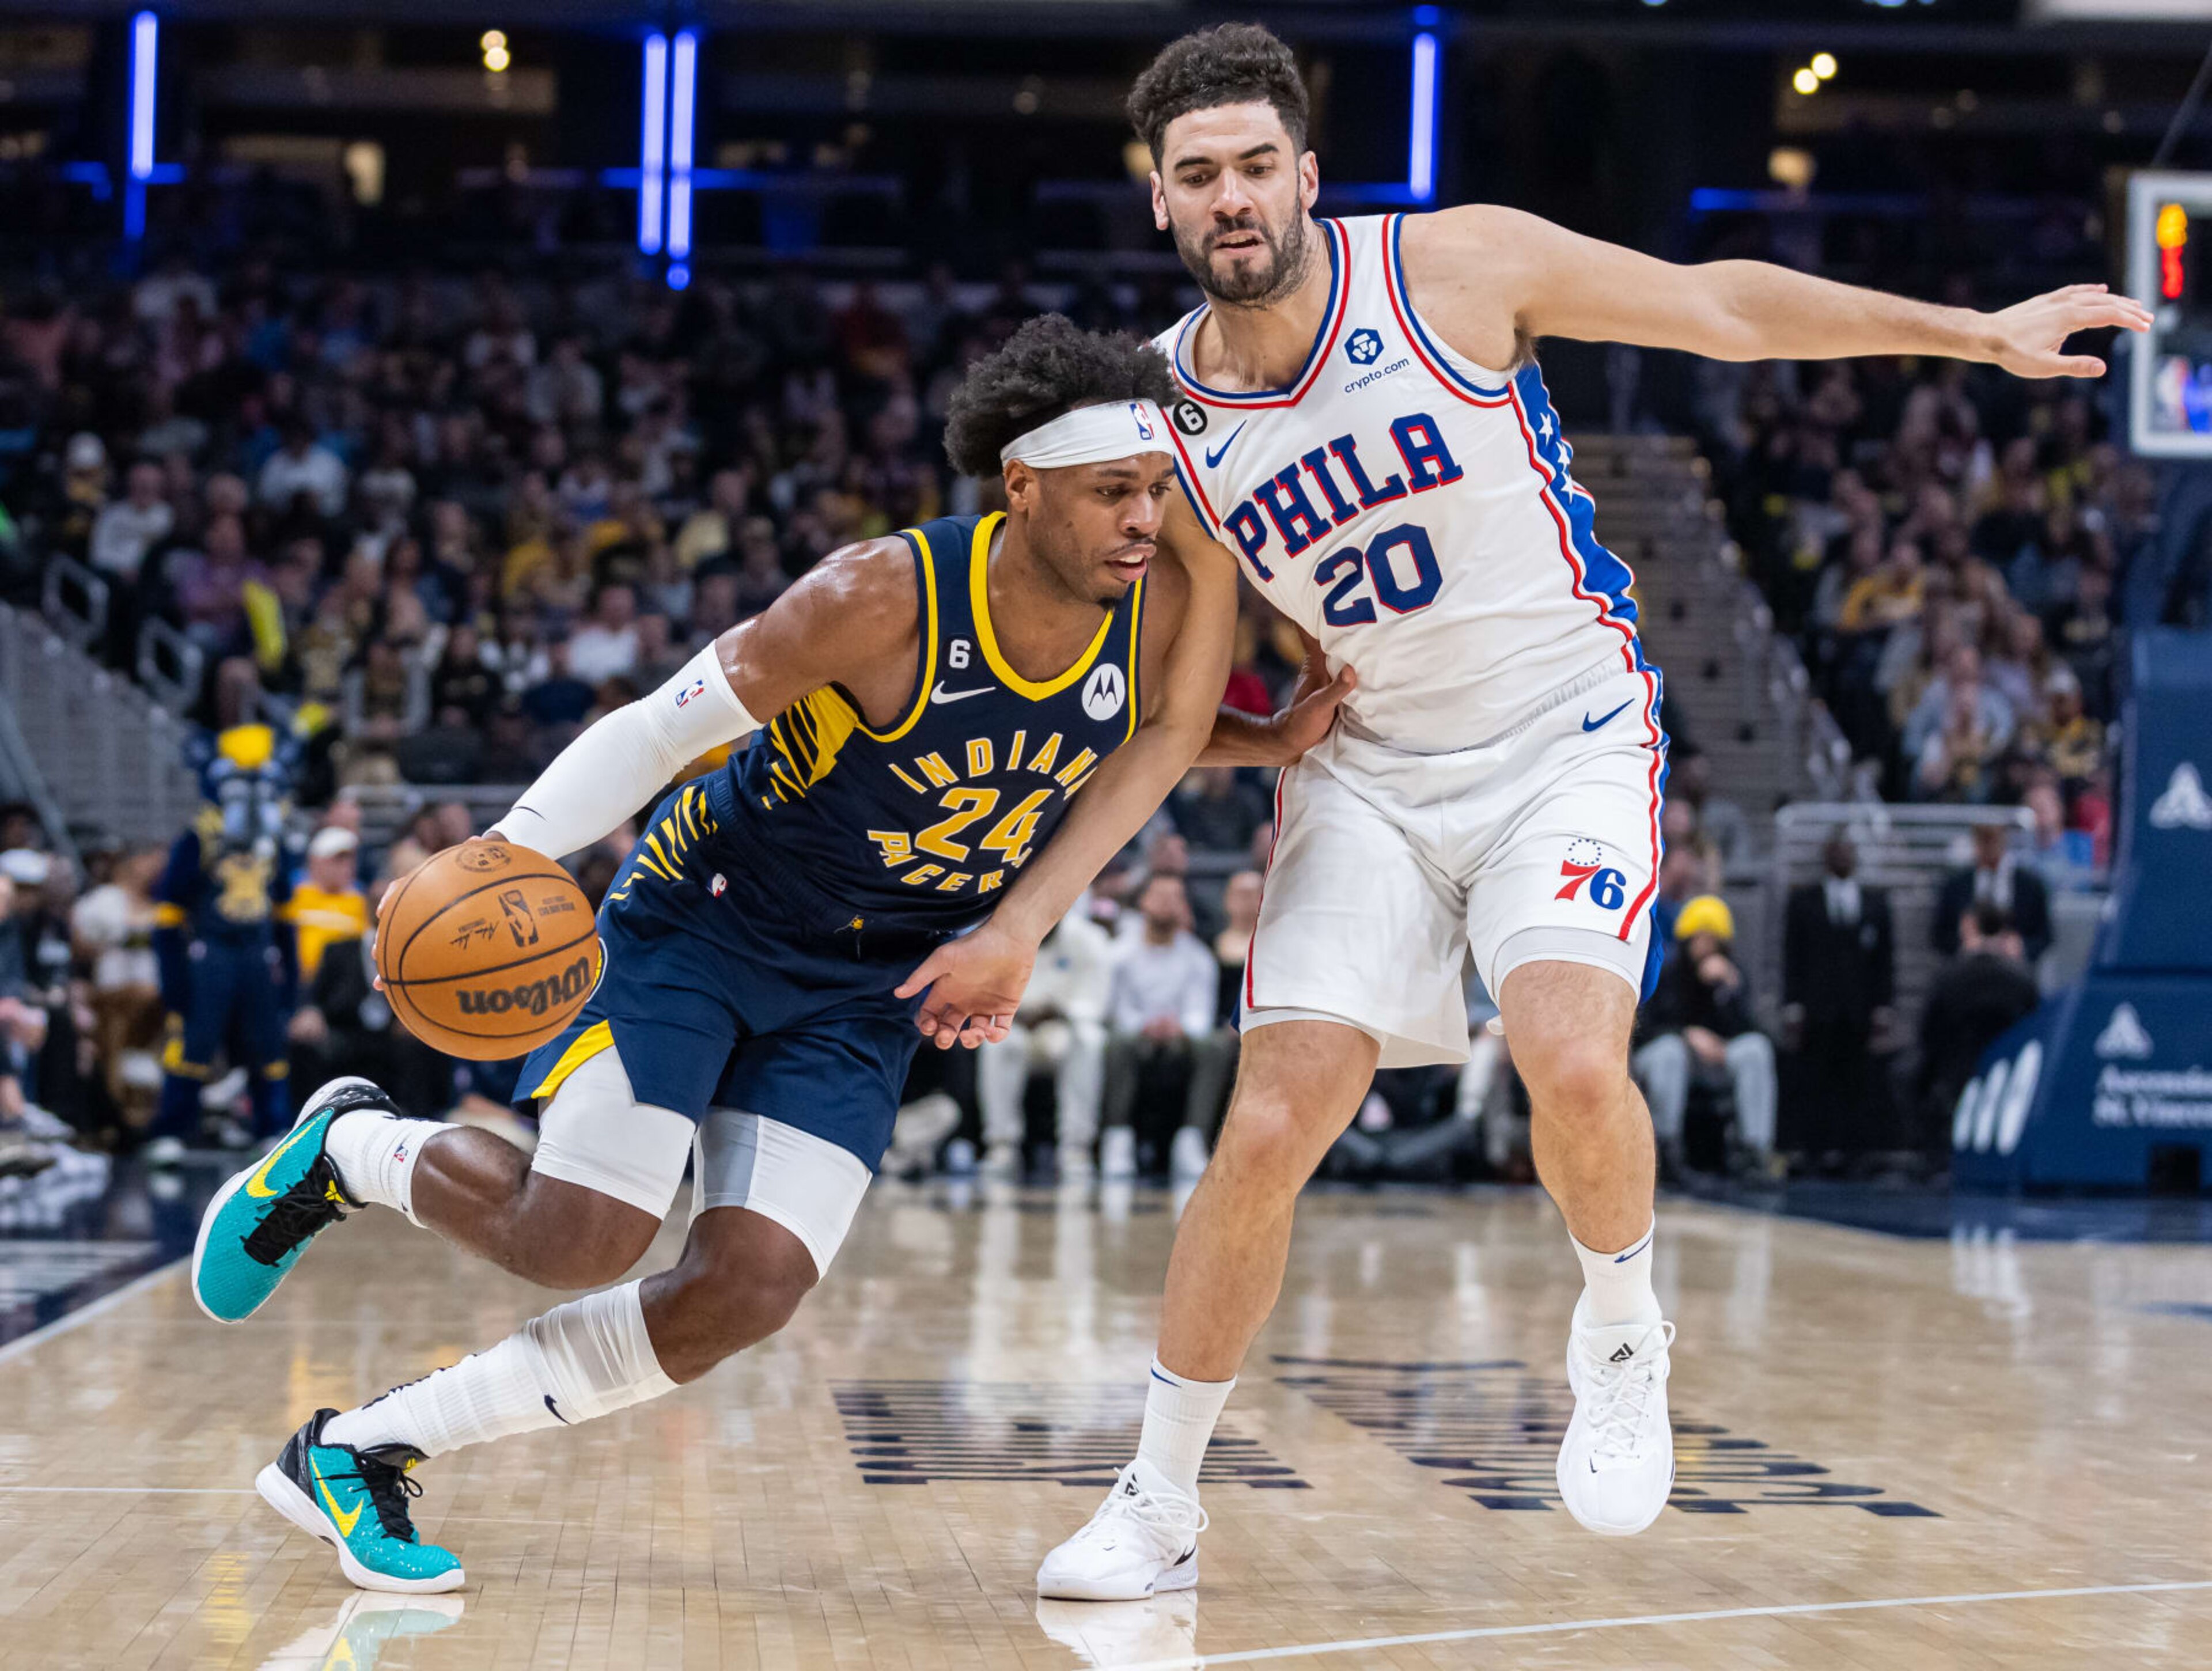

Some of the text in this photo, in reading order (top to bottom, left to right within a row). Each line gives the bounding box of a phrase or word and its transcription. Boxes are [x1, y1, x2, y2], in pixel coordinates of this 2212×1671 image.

[1344, 358, 1410, 393] crypto.com
[1179, 403, 1204, 431] 6
[1223, 412, 1464, 583] PHILA
[1314, 523, 1444, 626] 20
[949, 639, 971, 669] 6
[915, 787, 1054, 863] 24
[866, 829, 1033, 894] PACER
[1554, 859, 1626, 910] 76
[456, 957, 590, 1016] Wilson
